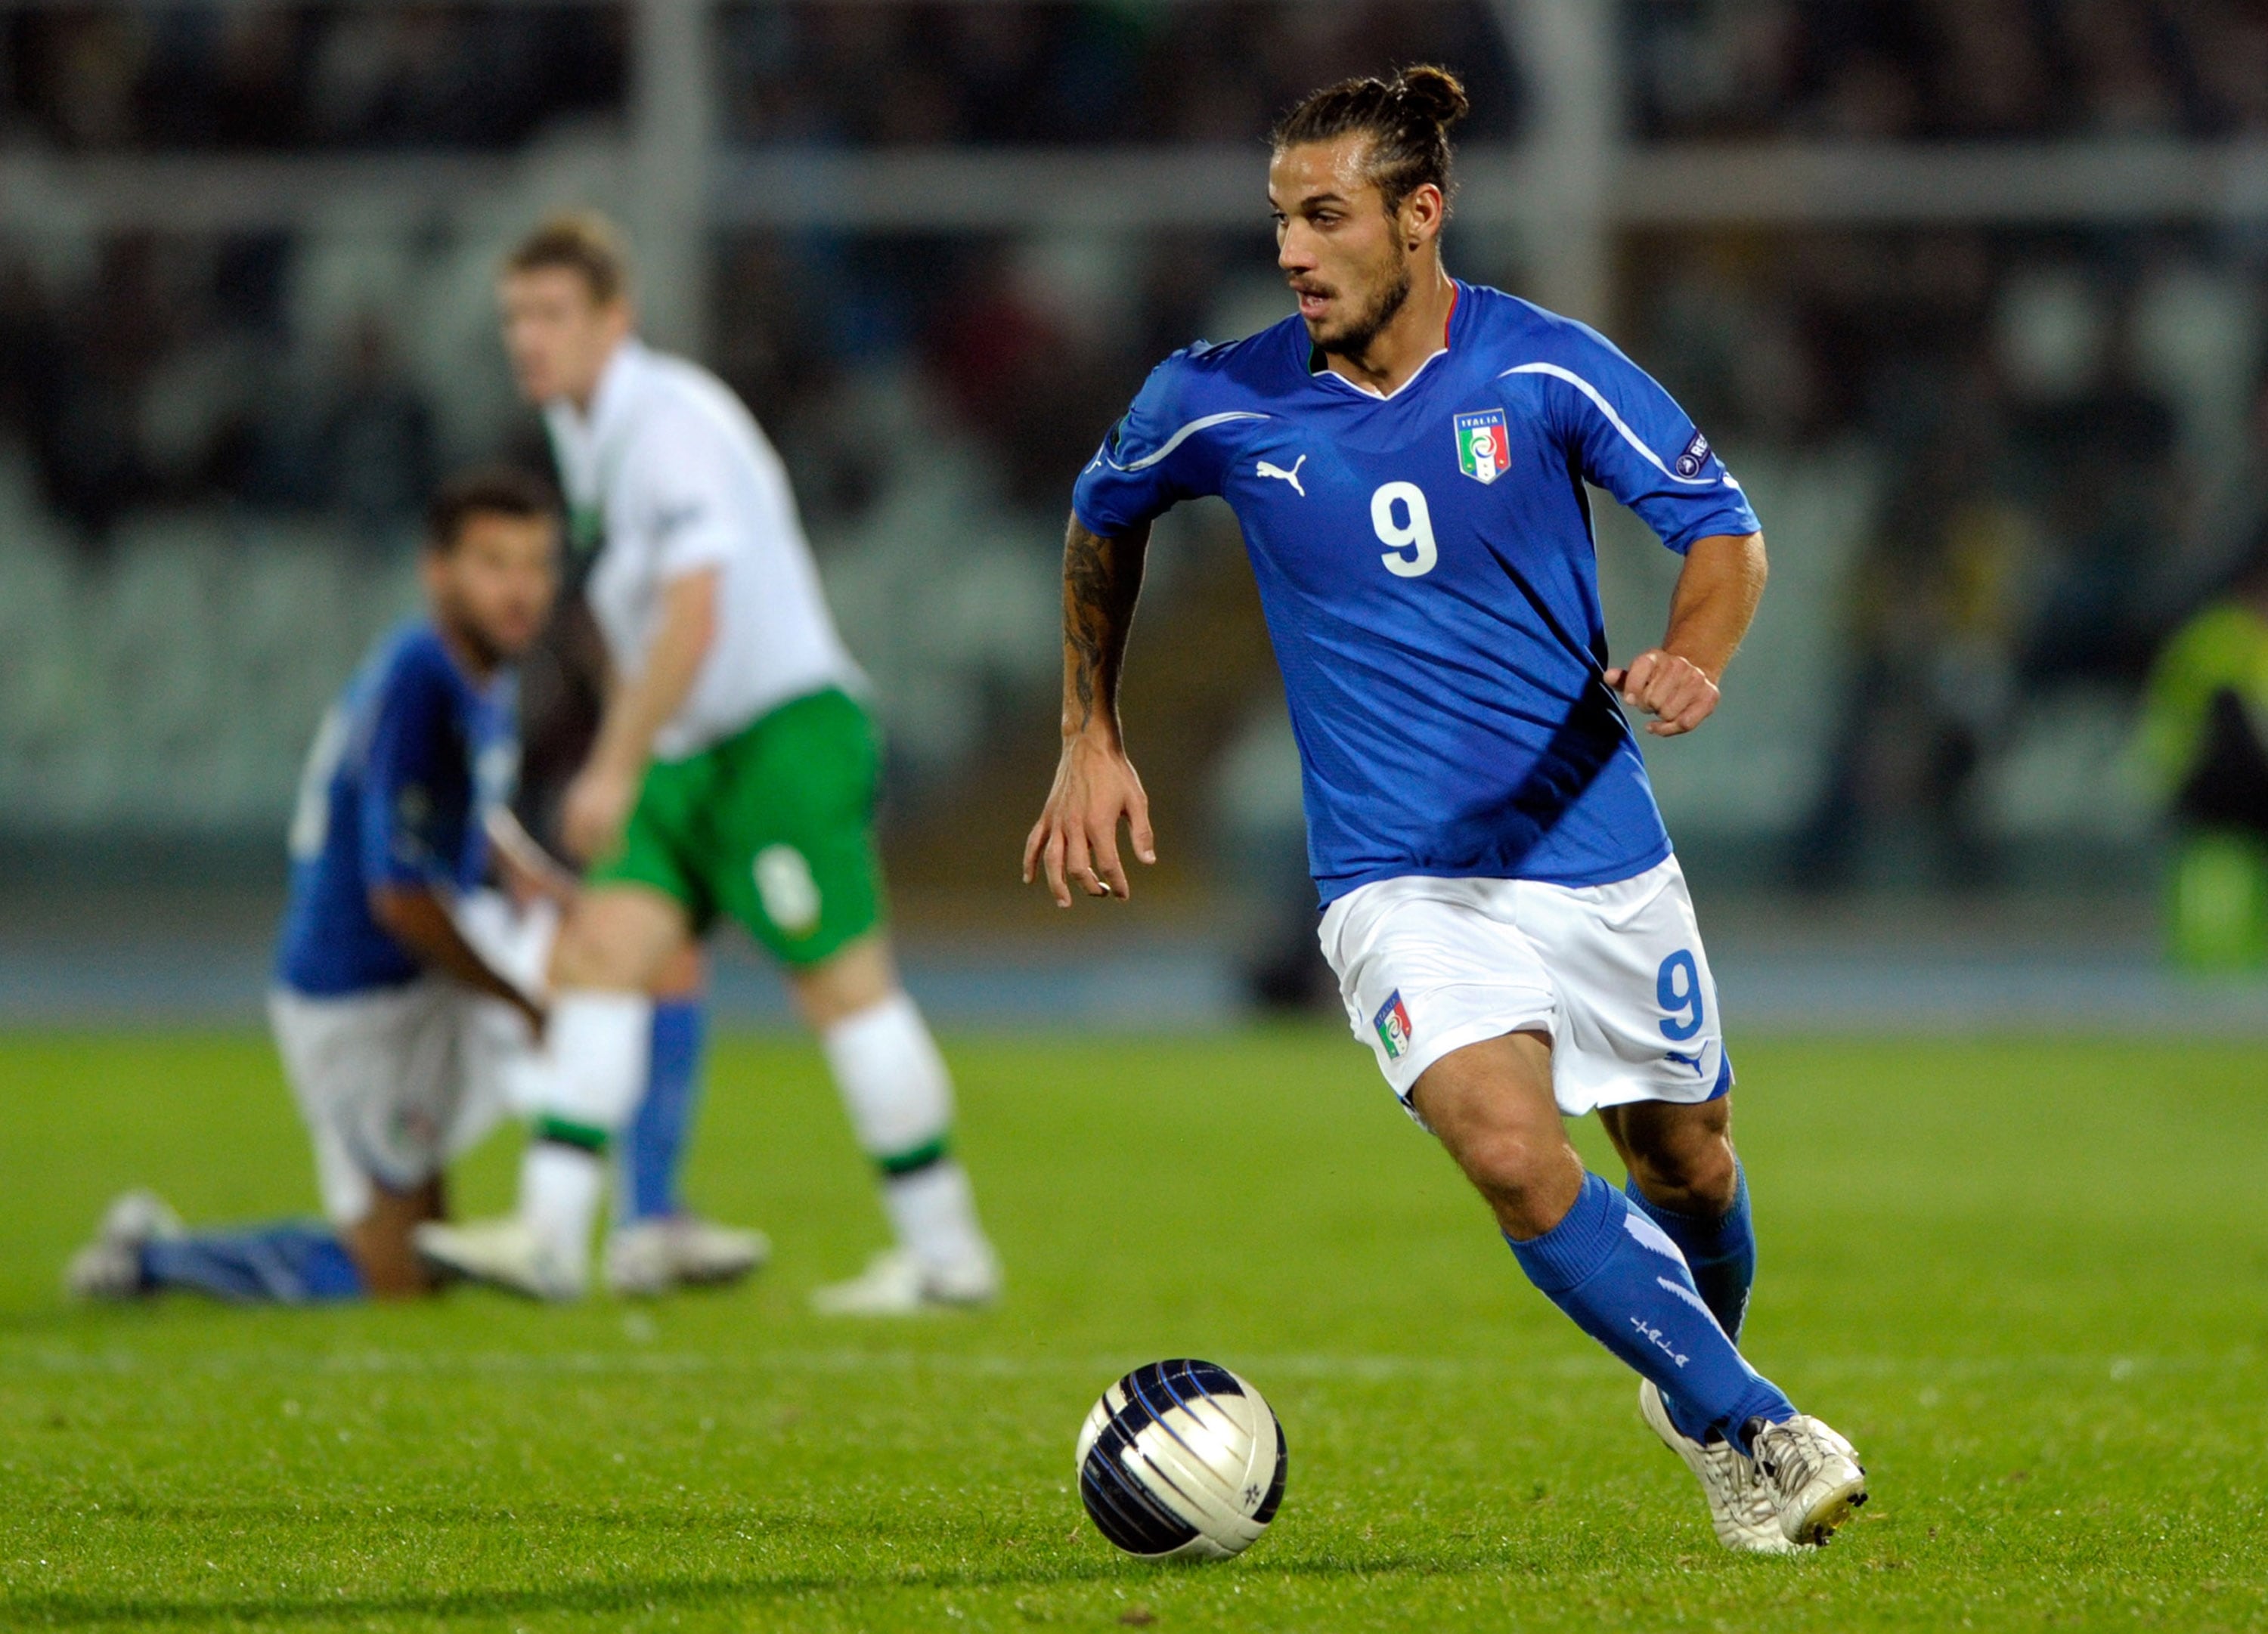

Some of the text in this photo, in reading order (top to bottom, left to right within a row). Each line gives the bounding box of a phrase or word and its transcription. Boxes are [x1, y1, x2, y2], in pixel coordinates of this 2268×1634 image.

[1461, 415, 1498, 428] ITALIA
[1370, 481, 1438, 578] 9
[1656, 949, 1703, 1041] 9
